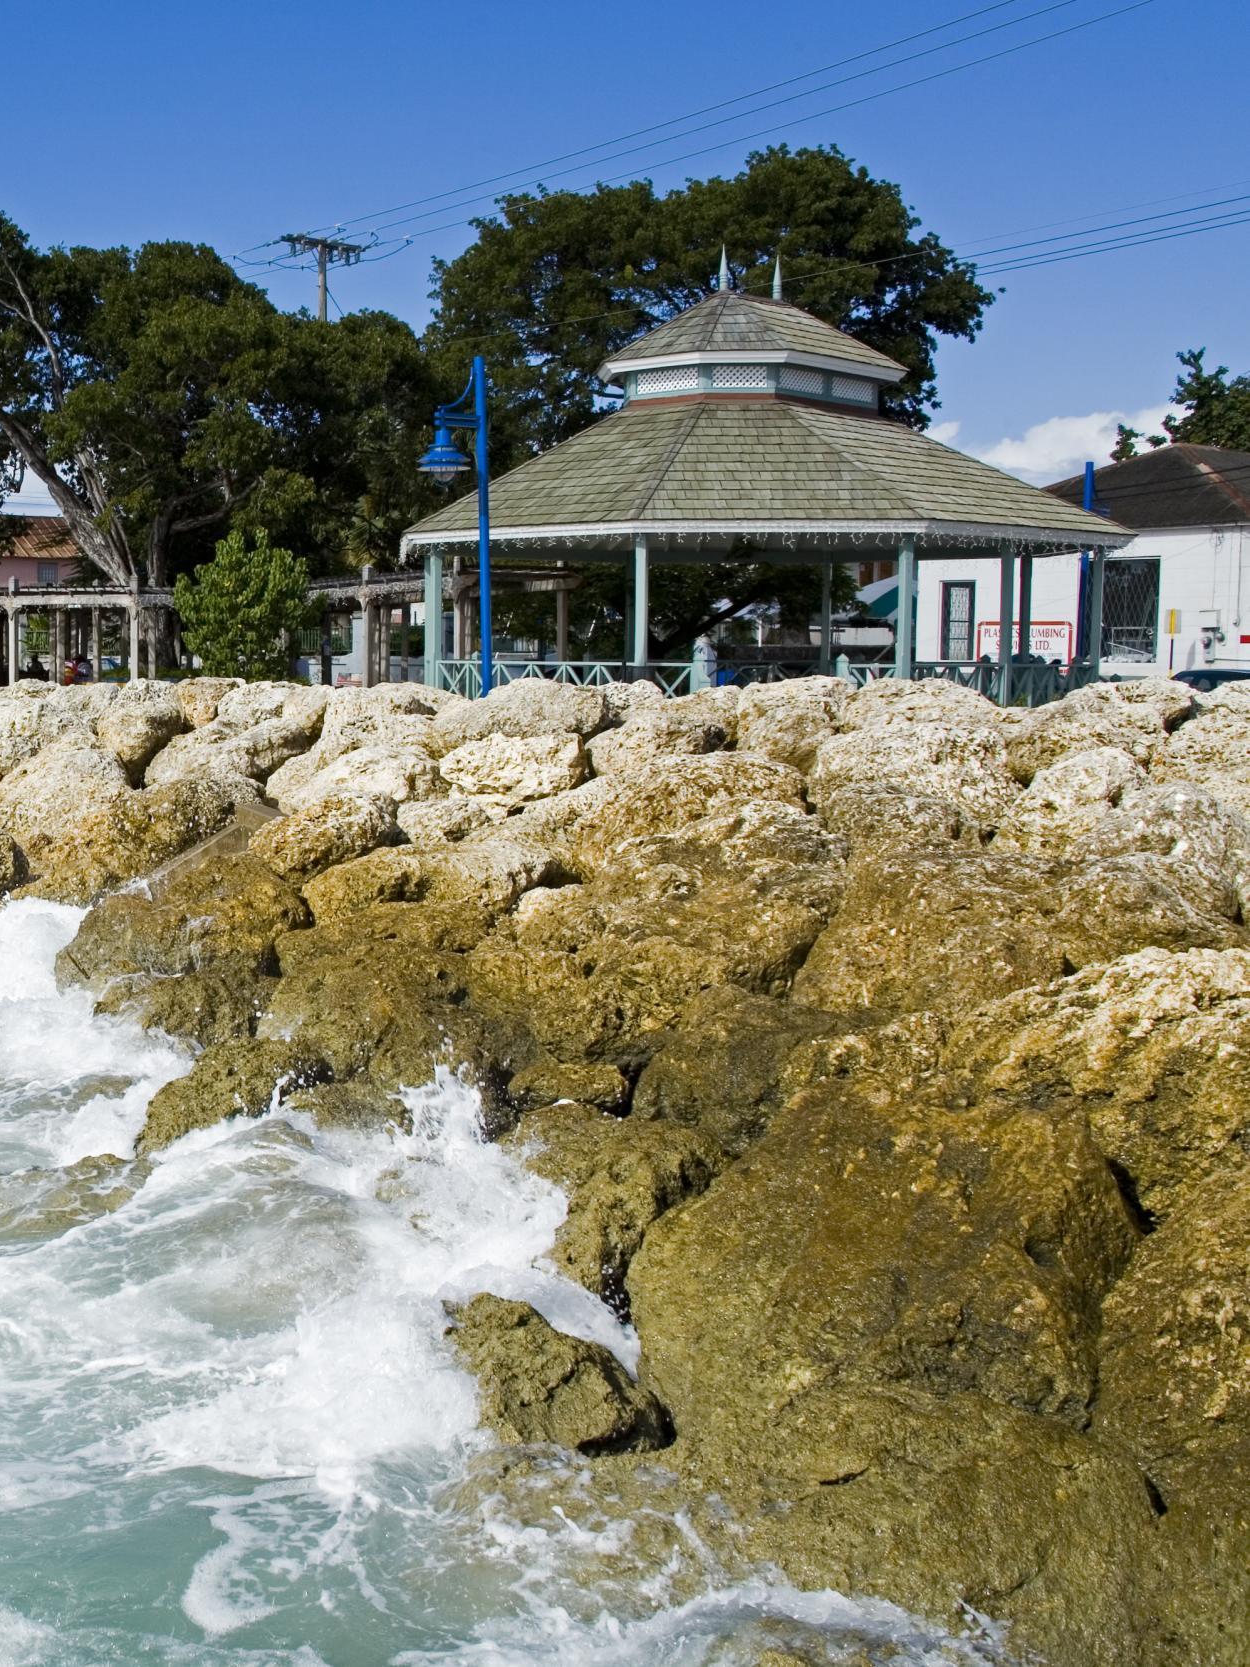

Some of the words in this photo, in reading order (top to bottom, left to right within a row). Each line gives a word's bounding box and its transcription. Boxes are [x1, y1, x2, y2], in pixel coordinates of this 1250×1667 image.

[984, 628, 1020, 638] PLASS
[1030, 628, 1065, 638] UMBING
[1035, 640, 1052, 650] LTD.
